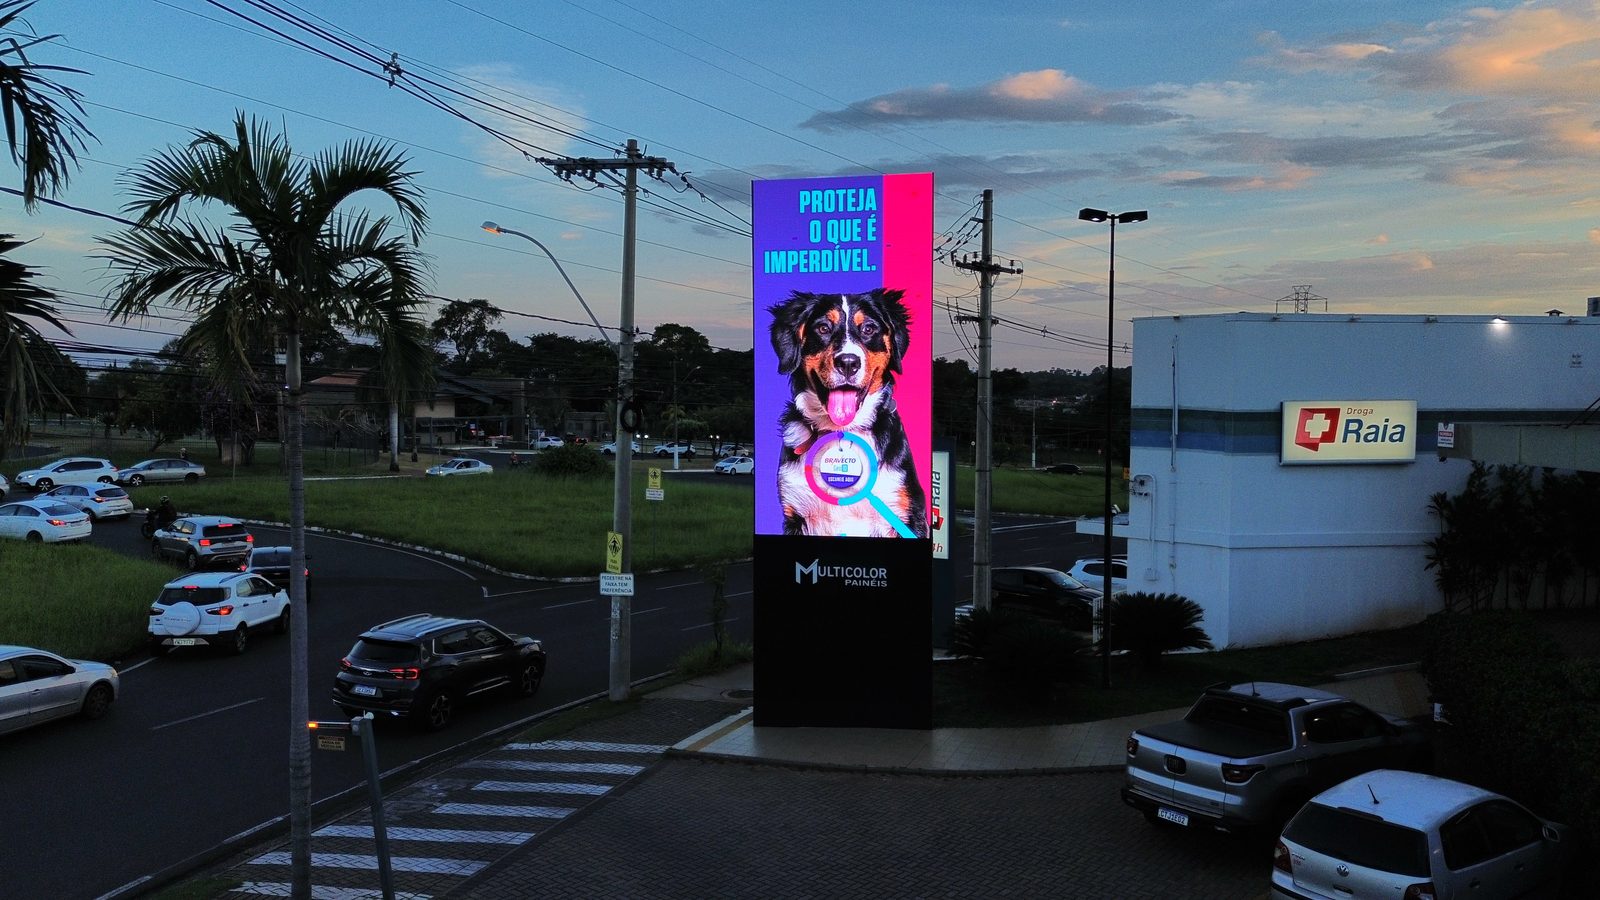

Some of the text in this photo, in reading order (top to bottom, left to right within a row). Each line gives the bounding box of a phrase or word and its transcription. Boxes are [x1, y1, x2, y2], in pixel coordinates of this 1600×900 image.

[800, 188, 877, 214] PROTEJA
[809, 214, 877, 245] O QUE É
[764, 244, 876, 274] IMPERDÍVEL.
[1346, 407, 1374, 416] Droga
[1342, 418, 1406, 443] Raia
[795, 558, 888, 584] MULTICOLOR
[844, 578, 888, 587] PAINÉIS
